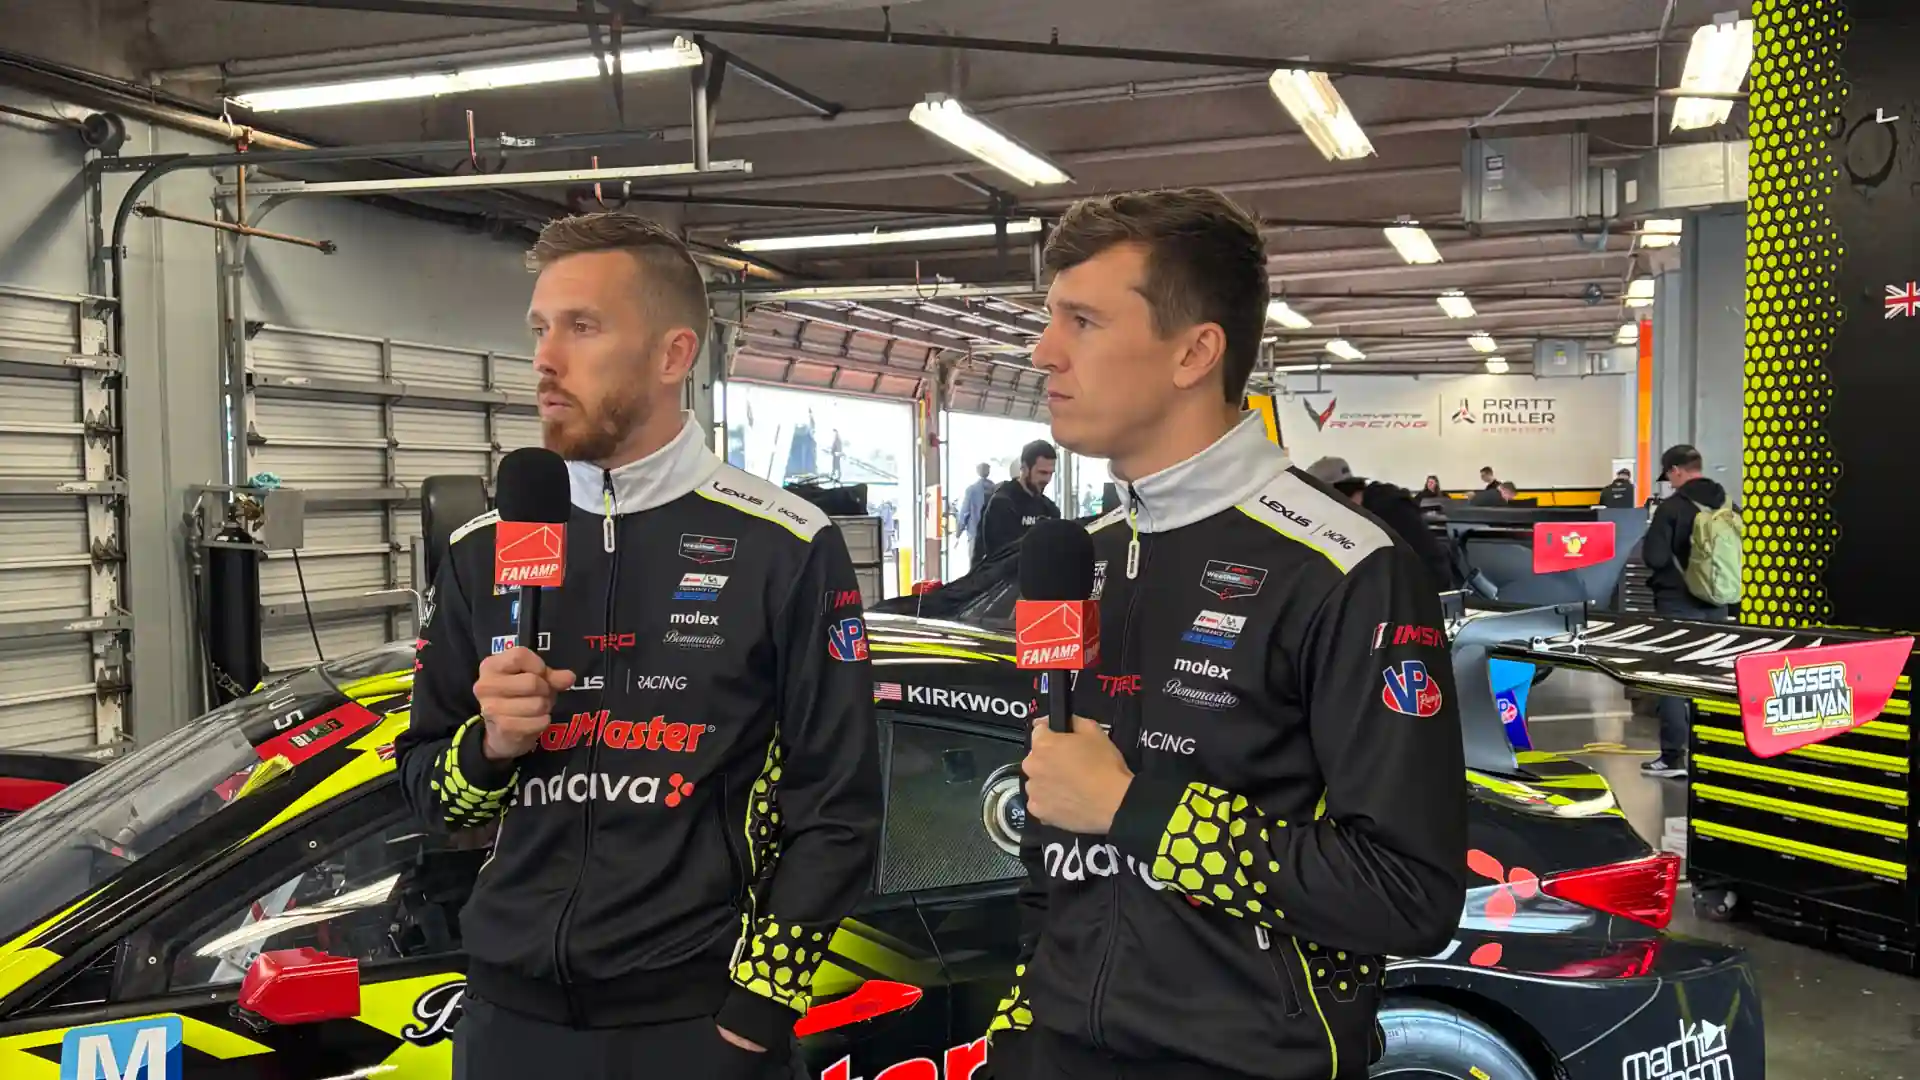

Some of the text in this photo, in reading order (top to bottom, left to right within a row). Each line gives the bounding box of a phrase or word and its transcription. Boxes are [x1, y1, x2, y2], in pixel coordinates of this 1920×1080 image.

[1483, 399, 1556, 409] PRATT
[1482, 413, 1555, 424] MILLER
[713, 481, 764, 506] LEXUS
[1259, 495, 1312, 527] LEXUS
[500, 563, 559, 582] FANAMP
[670, 610, 719, 625] molex
[582, 632, 636, 653] TRD
[1021, 643, 1080, 665] FANAMP
[1173, 657, 1231, 680] molex
[637, 675, 688, 690] RACING
[1162, 678, 1240, 706] Bommarito
[1382, 660, 1428, 715] VP
[1770, 664, 1845, 699] VASSER
[907, 685, 1029, 718] KIRKWOO
[1766, 689, 1850, 724] SULLIVAN
[533, 709, 706, 752] alMaster
[1137, 729, 1197, 755] ACING
[511, 766, 661, 807] ndava
